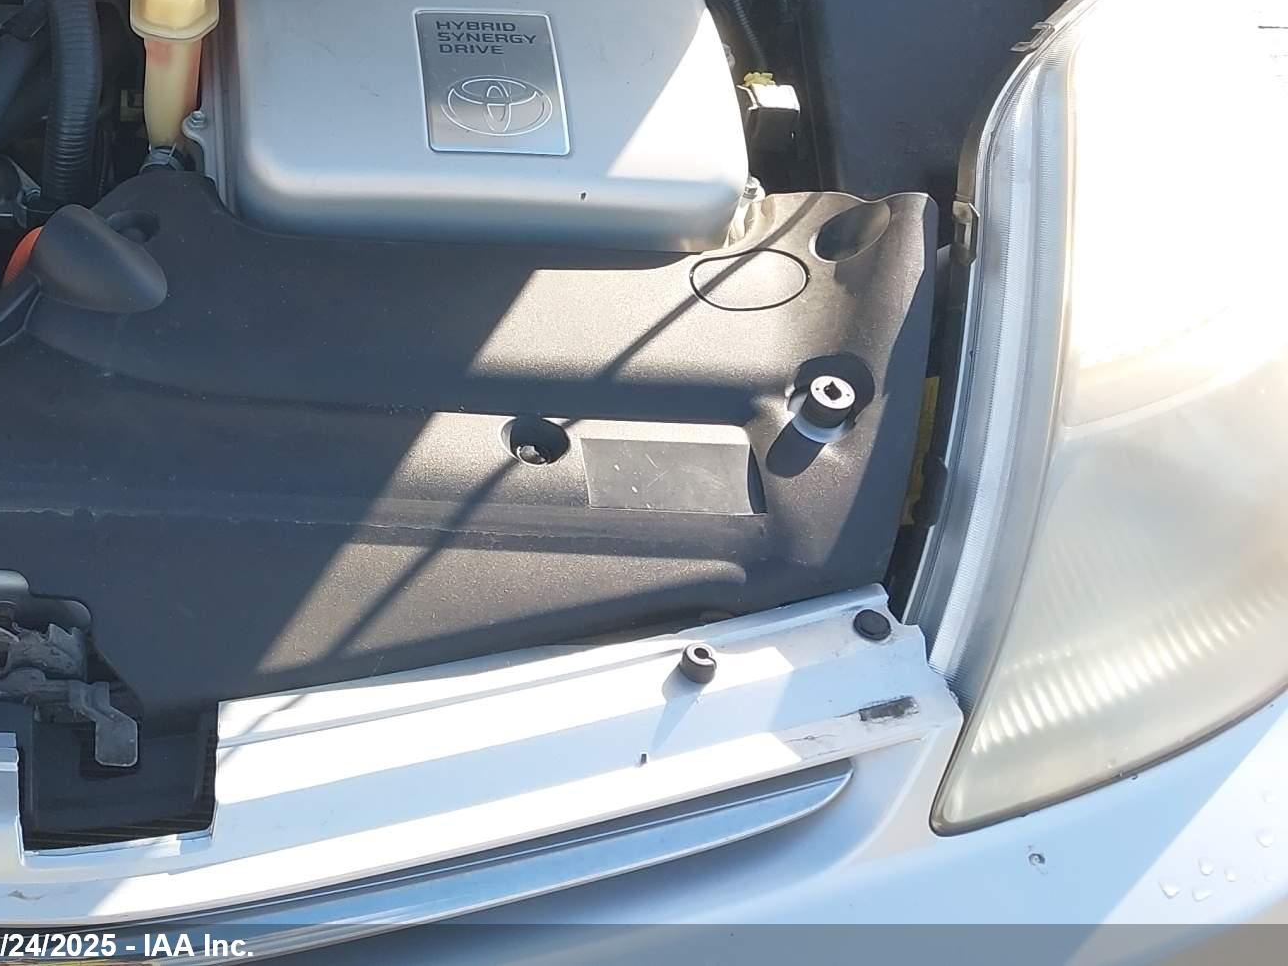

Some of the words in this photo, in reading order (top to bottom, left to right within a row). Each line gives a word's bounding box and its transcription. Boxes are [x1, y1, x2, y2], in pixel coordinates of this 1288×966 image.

[435, 20, 516, 32] HYBRID
[437, 32, 537, 44] SYNERGY
[439, 44, 504, 54] DRIVE
